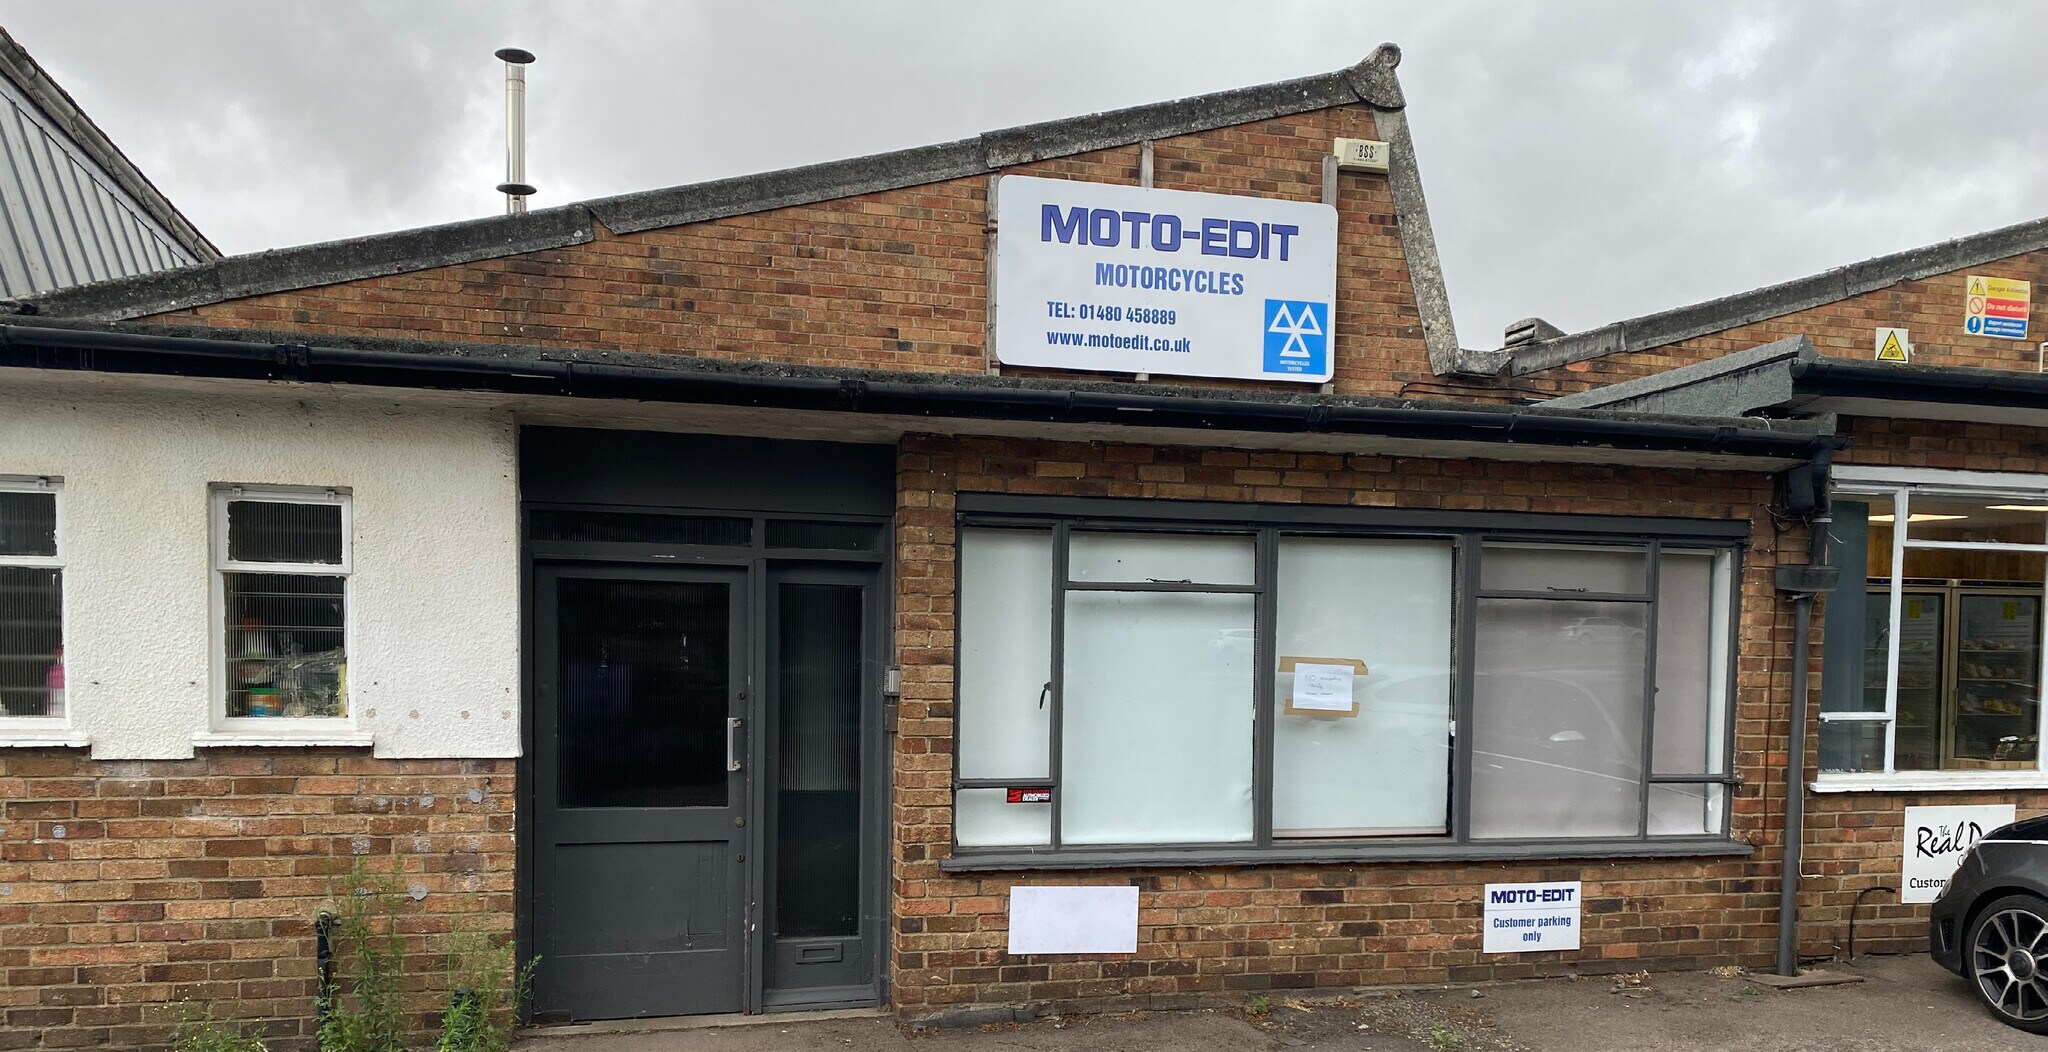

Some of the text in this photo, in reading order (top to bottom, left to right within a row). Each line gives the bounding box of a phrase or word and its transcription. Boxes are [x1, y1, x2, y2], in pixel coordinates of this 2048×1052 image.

[1359, 145, 1374, 158] BSS
[1041, 204, 1299, 262] MOTO-EDIT
[1095, 262, 1245, 296] MOTORCYCLES
[1047, 301, 1176, 325] TEL: 01480 458889
[1047, 331, 1191, 353] www.motoedit.co.uk
[1916, 821, 1964, 858] Real
[1938, 825, 1951, 837] The
[1491, 888, 1575, 904] MOTO-EDIT
[1493, 916, 1571, 928] Customer parking
[1522, 931, 1542, 942] only
